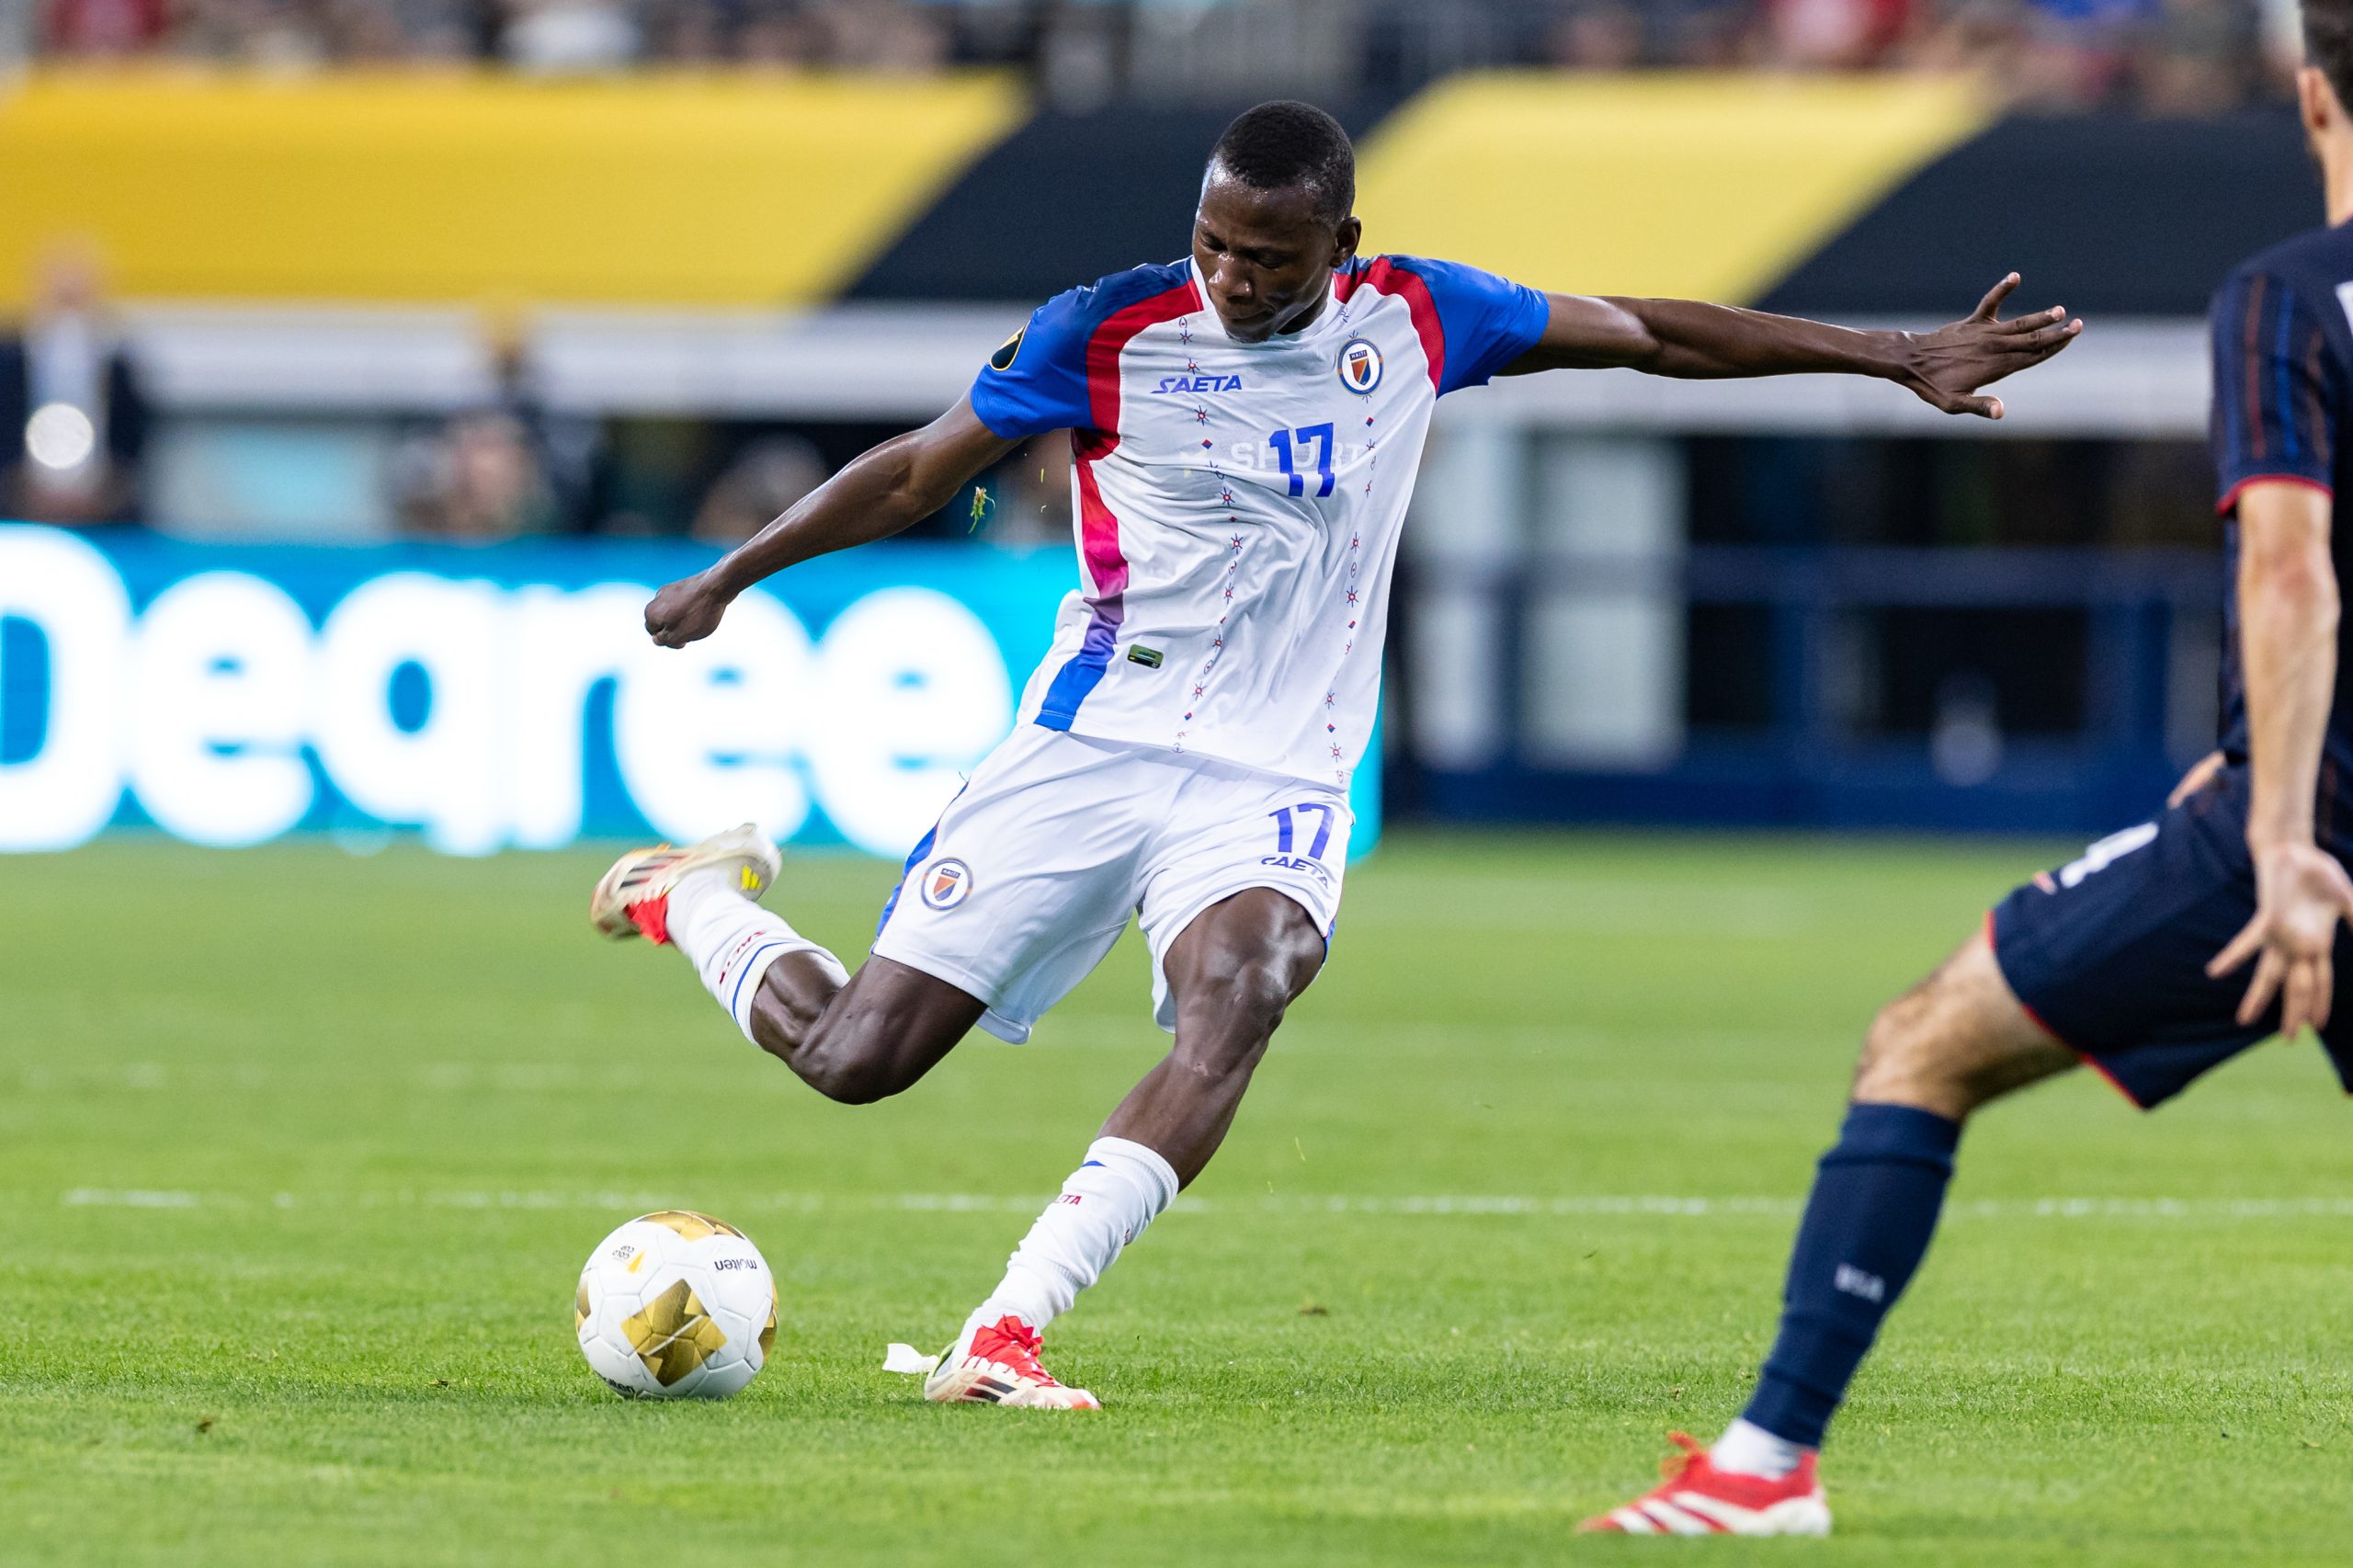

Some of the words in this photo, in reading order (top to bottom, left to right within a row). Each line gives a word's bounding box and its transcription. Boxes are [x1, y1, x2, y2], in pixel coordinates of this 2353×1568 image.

[1151, 374, 1242, 394] SAETA
[1268, 422, 1335, 497] 17
[1268, 802, 1336, 861] 17
[714, 1258, 757, 1272] molten
